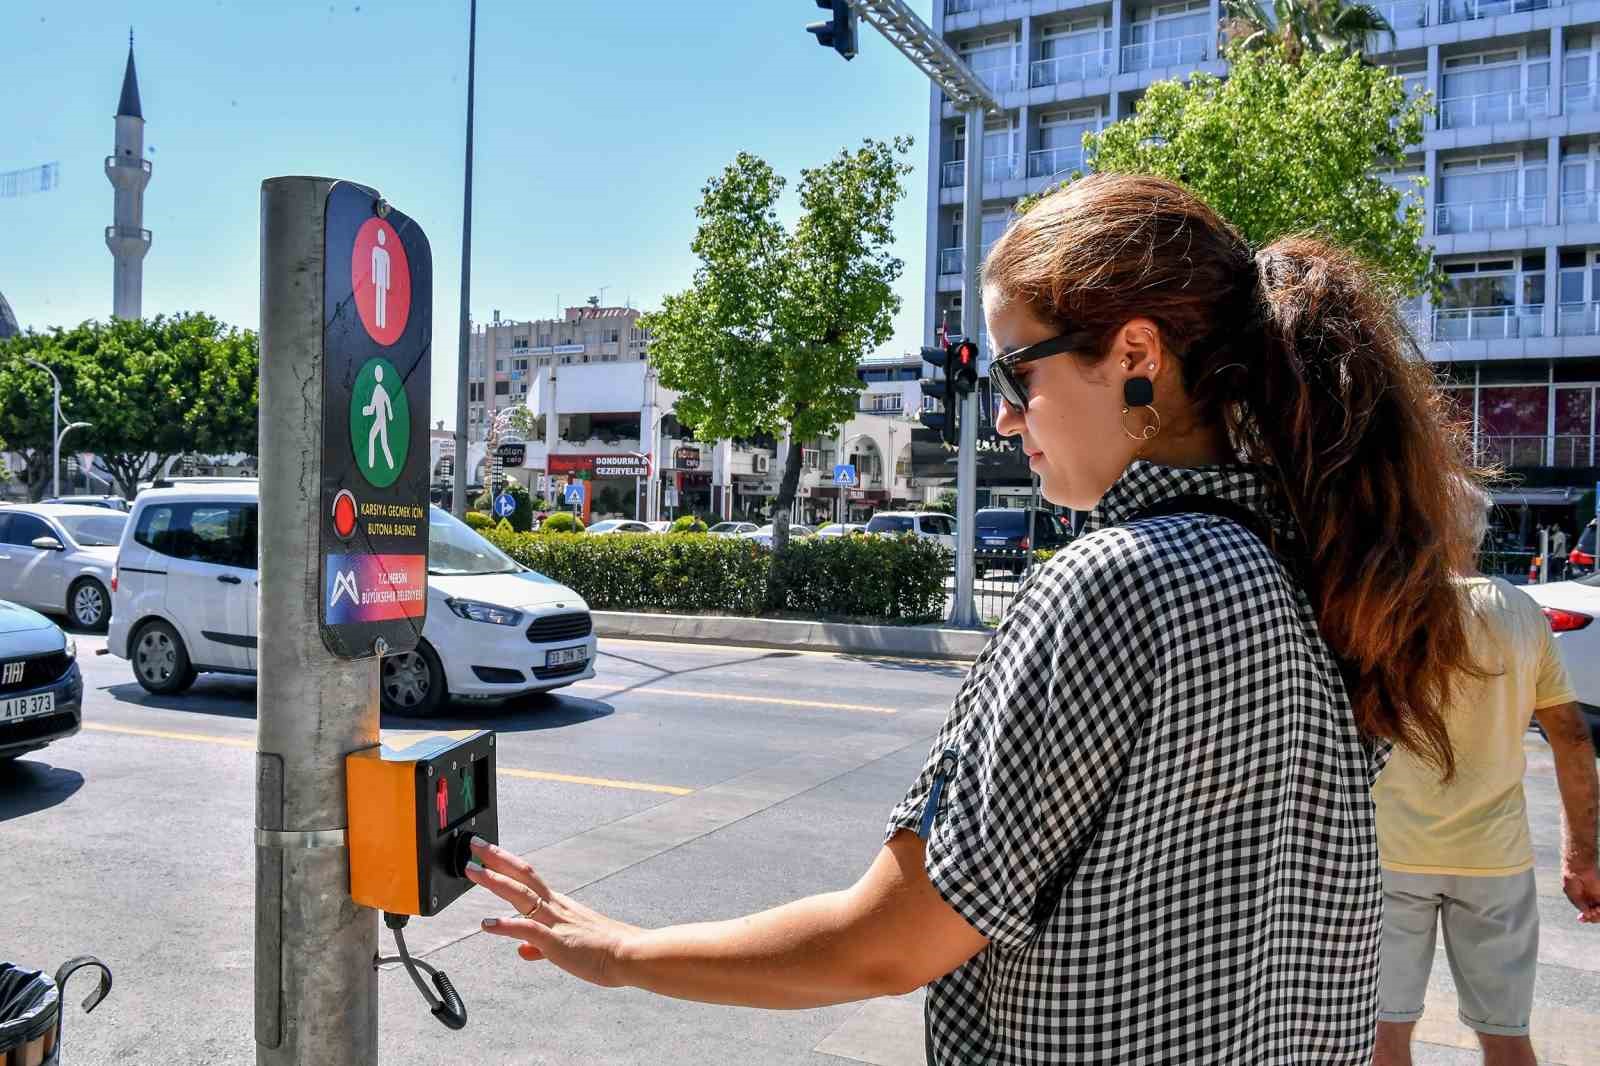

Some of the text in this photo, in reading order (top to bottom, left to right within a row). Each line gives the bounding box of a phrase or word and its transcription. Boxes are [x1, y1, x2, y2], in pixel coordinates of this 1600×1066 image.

[596, 457, 640, 465] DONDURMA
[368, 523, 393, 536] BUTONA
[1, 661, 26, 685] FIAT
[31, 695, 51, 713] 373
